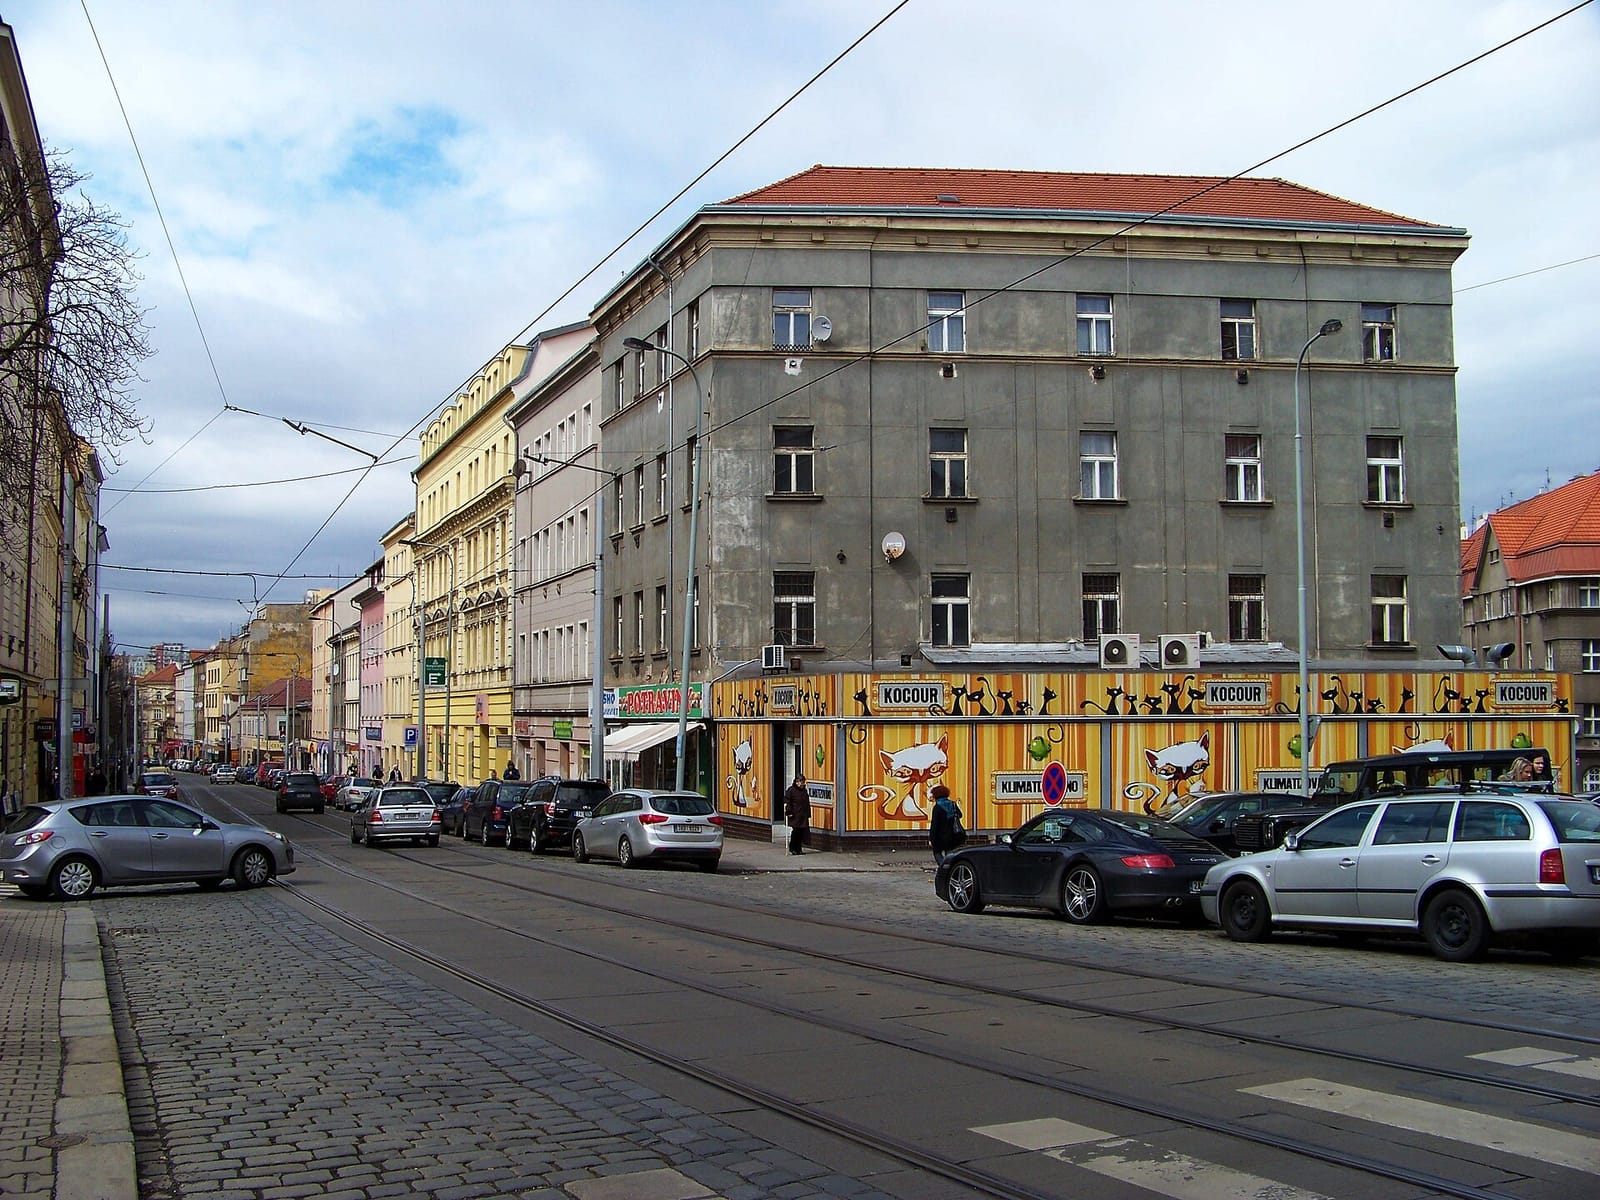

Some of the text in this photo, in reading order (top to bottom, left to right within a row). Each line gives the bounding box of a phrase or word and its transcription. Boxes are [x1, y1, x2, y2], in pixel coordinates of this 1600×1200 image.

[884, 688, 938, 703] KOCOUR
[1210, 687, 1261, 701] KOCOUR
[1500, 686, 1548, 701] KOCOUR
